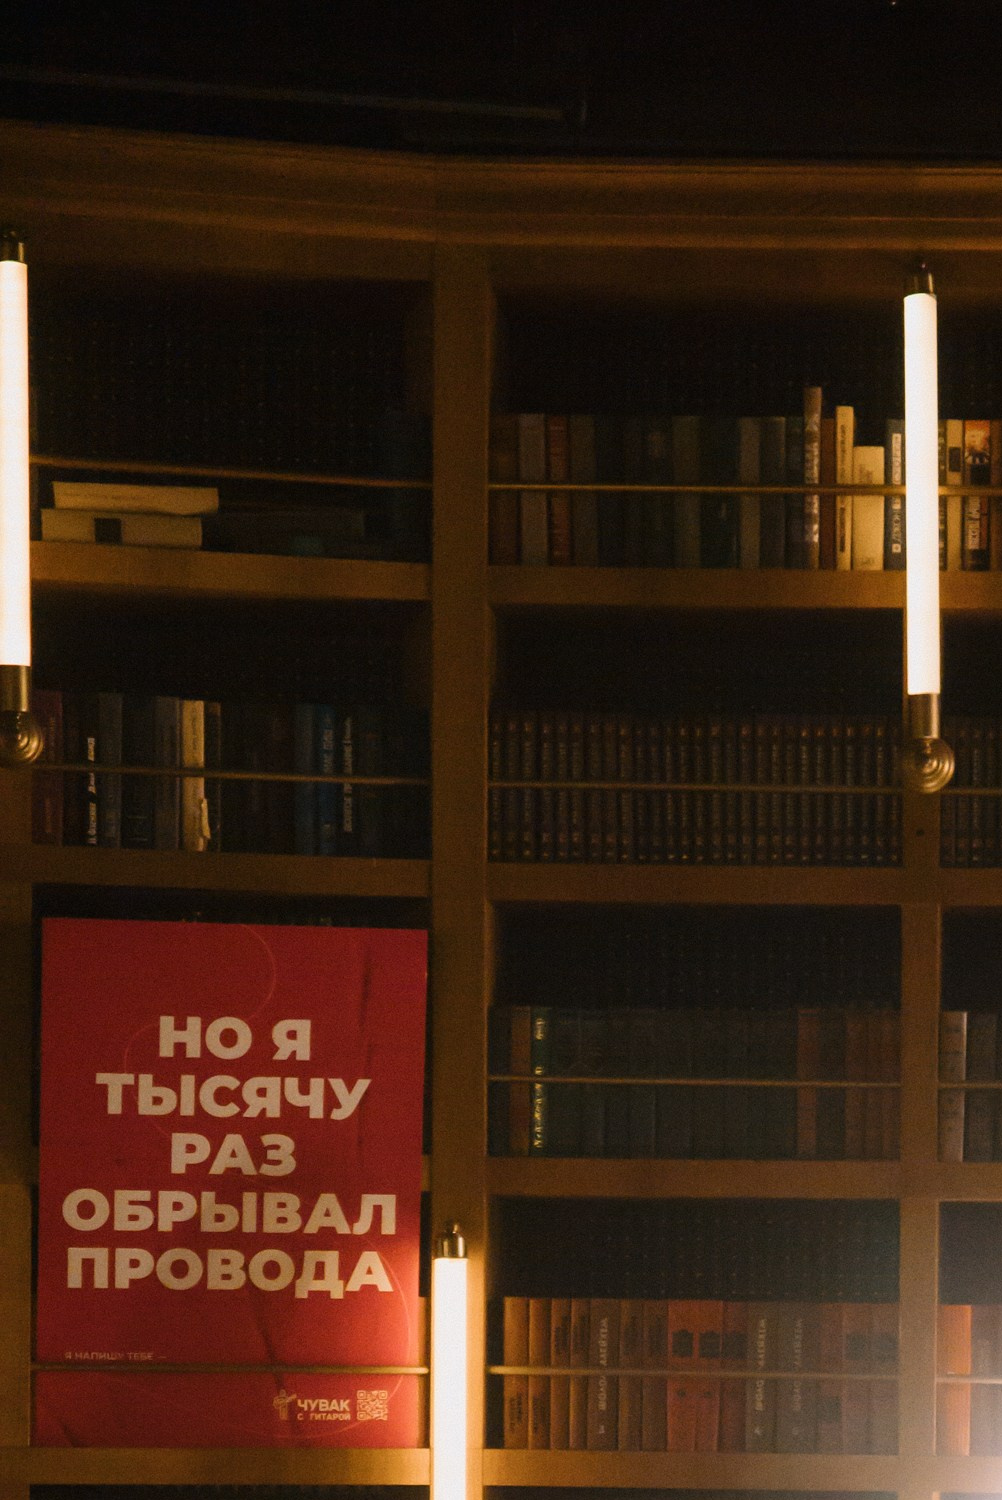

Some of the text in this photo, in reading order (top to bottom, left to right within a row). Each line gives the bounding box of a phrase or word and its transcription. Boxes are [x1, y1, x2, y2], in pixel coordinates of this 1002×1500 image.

[159, 1015, 311, 1061] НО Я
[95, 1072, 372, 1120] ТЫСЯЧУ
[170, 1132, 297, 1177] РАЗ
[61, 1188, 397, 1235] ОБРЫВАЛ
[67, 1246, 394, 1299] ПРОВОДА
[64, 1351, 72, 1361] Я
[127, 1351, 154, 1361] ТЕБЕ
[297, 1398, 351, 1412] ЧУВАК
[297, 1412, 352, 1421] С ГИТАРОЙ
